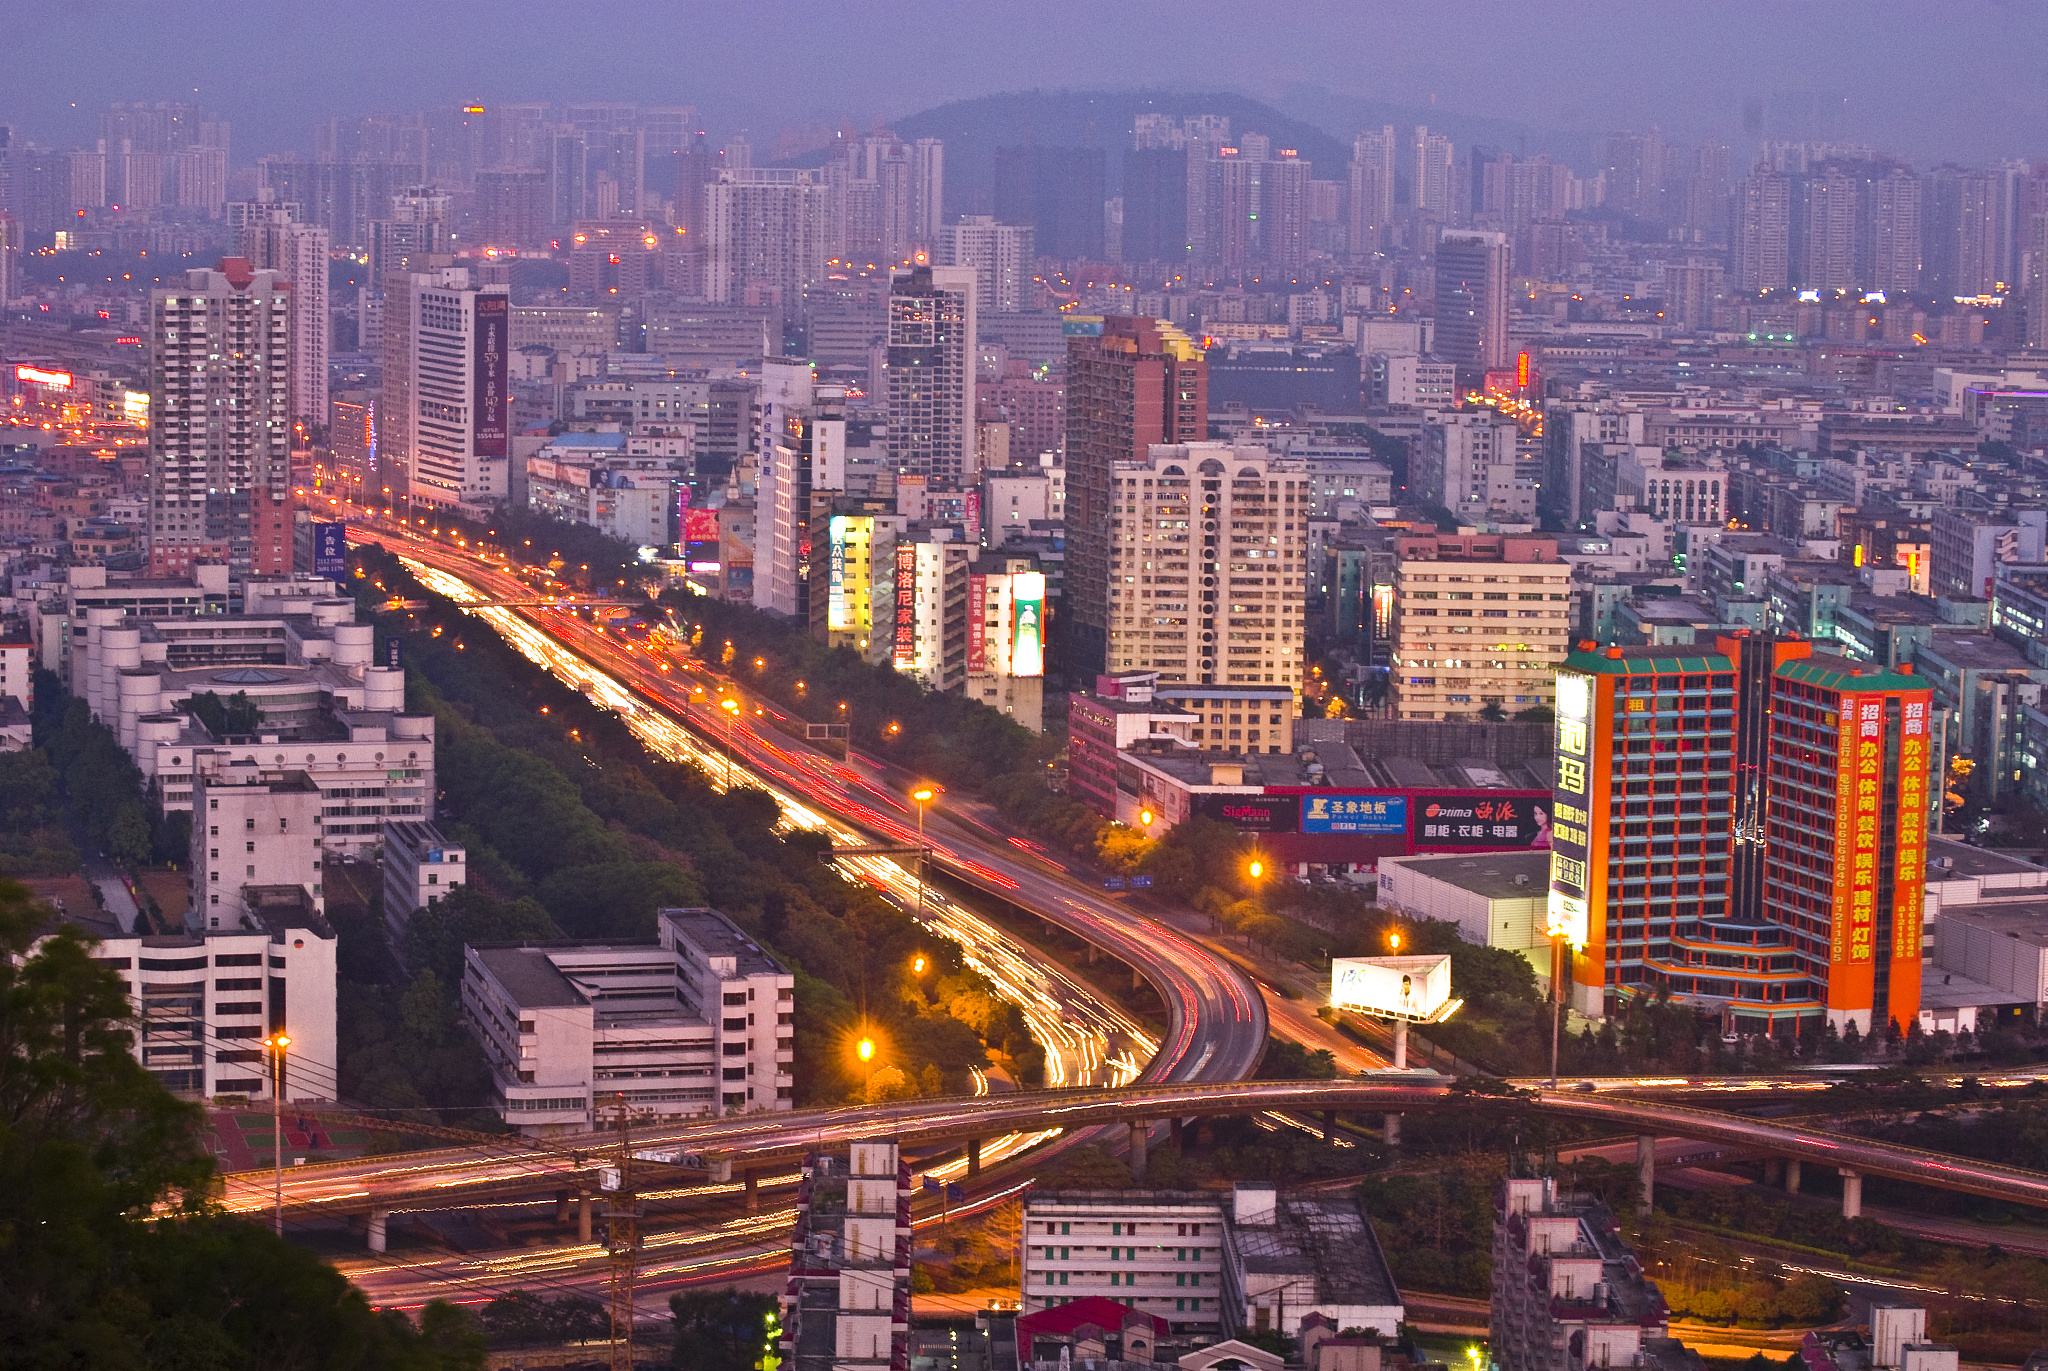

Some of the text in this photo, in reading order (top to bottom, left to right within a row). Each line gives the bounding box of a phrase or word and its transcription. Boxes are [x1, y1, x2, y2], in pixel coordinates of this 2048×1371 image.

[324, 526, 336, 556] 广告位
[896, 553, 914, 643] 博洛尼家装
[972, 584, 982, 617] 凯迪拉克
[972, 623, 982, 648] 雪佛兰
[1629, 699, 1644, 711] 租
[1842, 698, 1854, 720] 招商
[1861, 704, 1879, 737] 招商
[1905, 702, 1924, 735] 招商
[1839, 773, 1850, 796] 电话
[1223, 805, 1271, 818] SigMann
[1331, 800, 1387, 815] 圣象地板
[1475, 801, 1518, 822] 欧派
